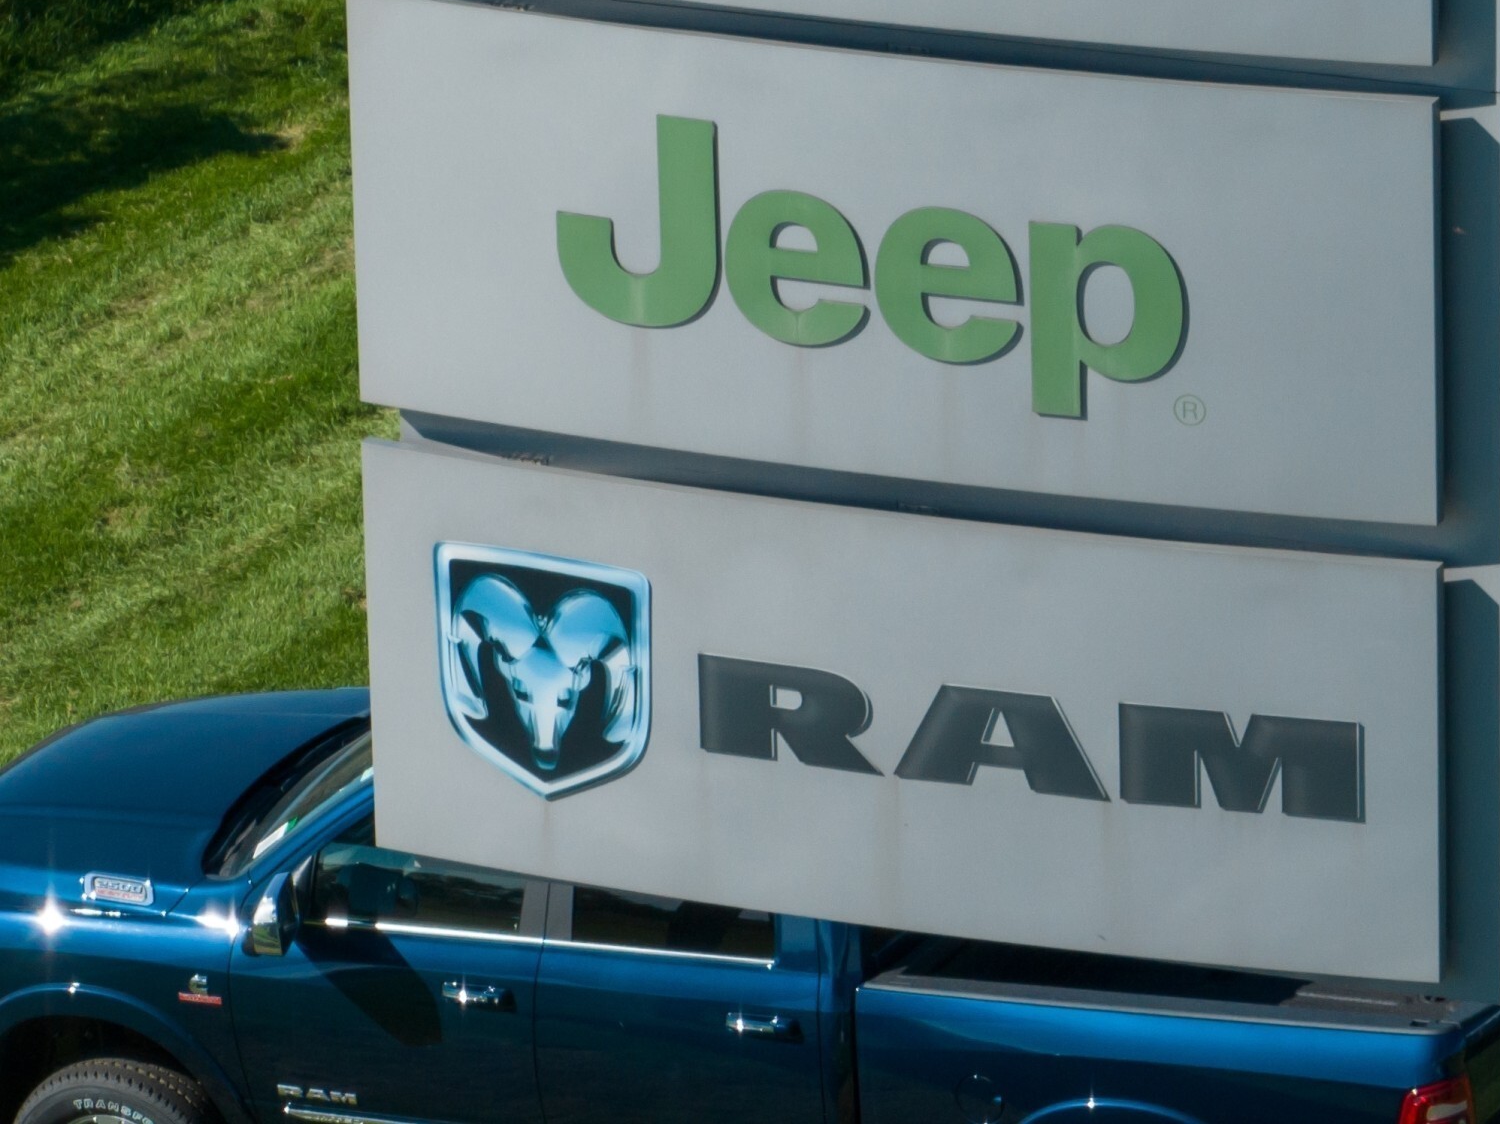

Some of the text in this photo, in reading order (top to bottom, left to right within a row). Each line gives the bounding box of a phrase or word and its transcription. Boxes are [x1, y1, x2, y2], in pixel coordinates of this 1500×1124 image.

[556, 114, 1191, 421] Jeep
[697, 653, 1367, 825] RAM
[277, 1084, 358, 1105] RAM
